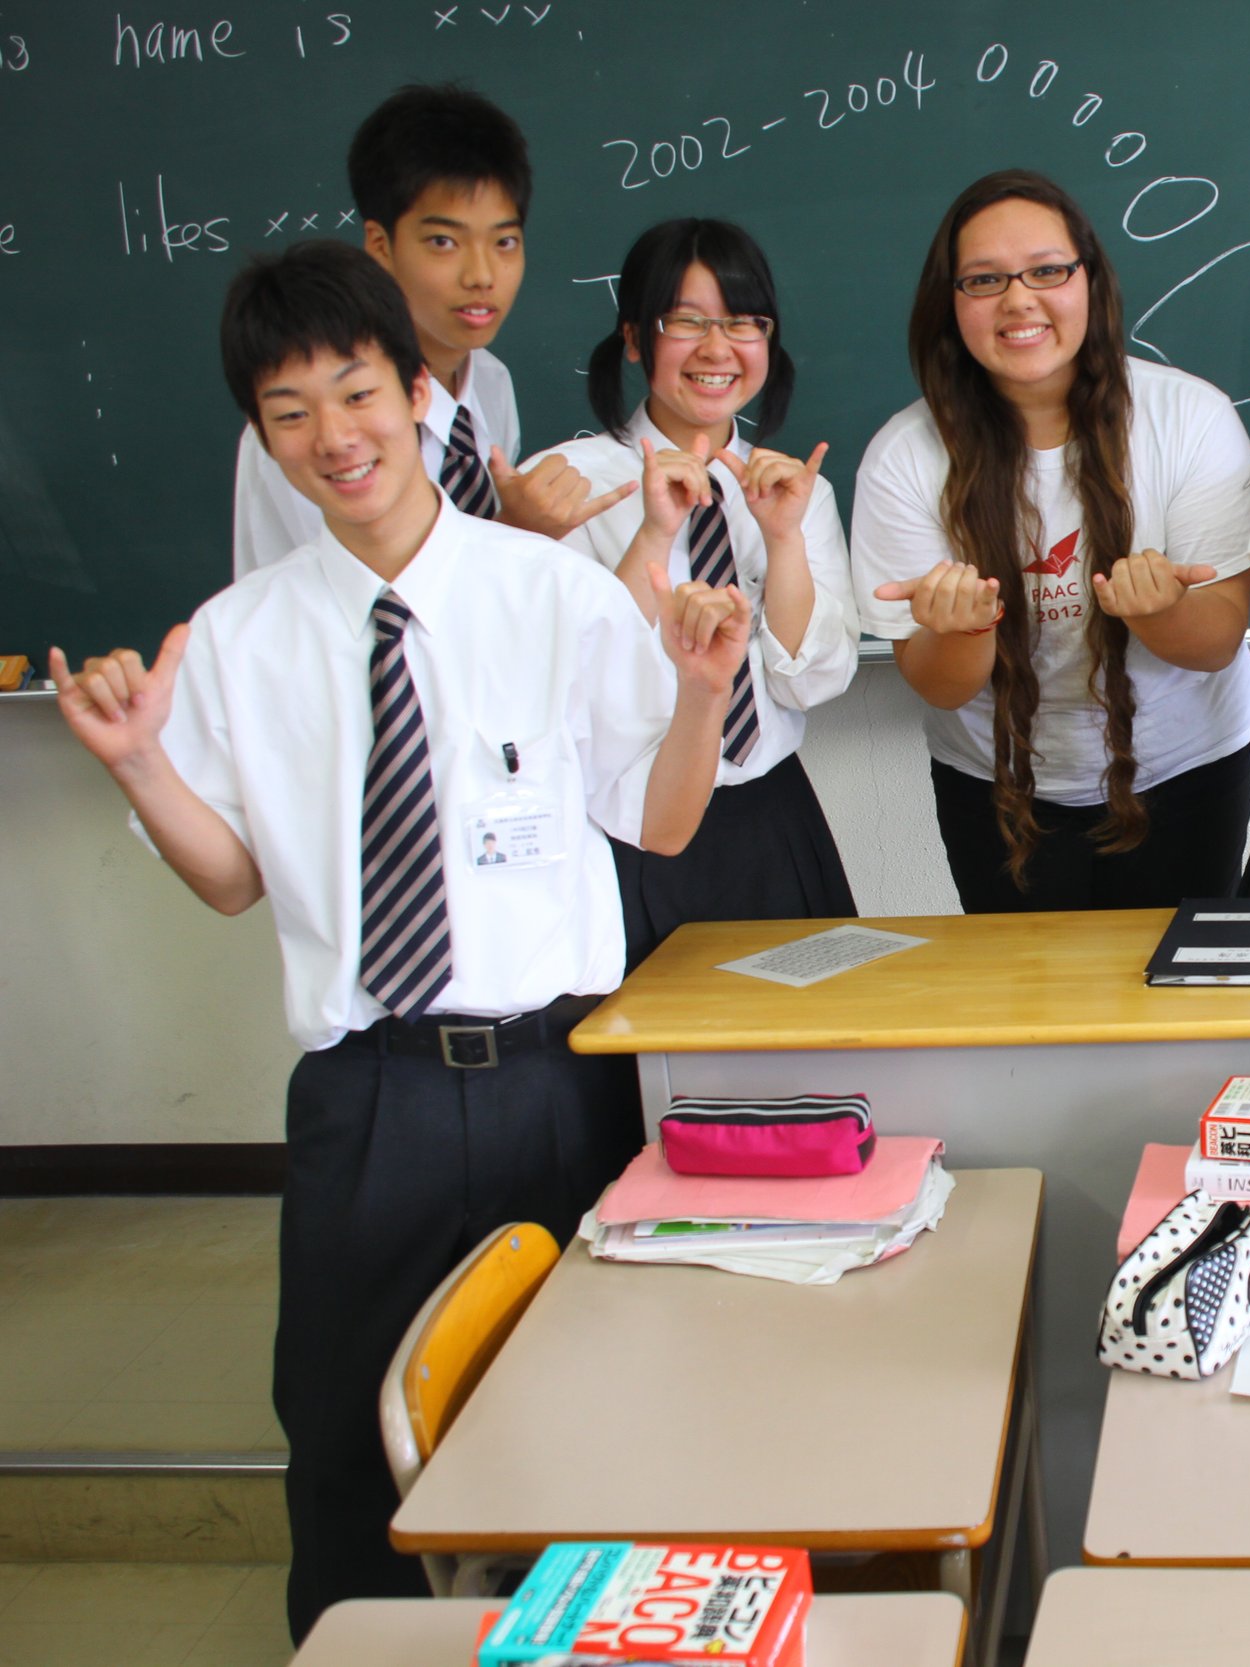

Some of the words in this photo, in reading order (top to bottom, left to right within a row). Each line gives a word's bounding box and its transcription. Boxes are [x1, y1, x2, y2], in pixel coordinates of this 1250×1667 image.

[296, 13, 352, 58] is
[119, 173, 231, 263] likes
[1035, 604, 1083, 623] 2012
